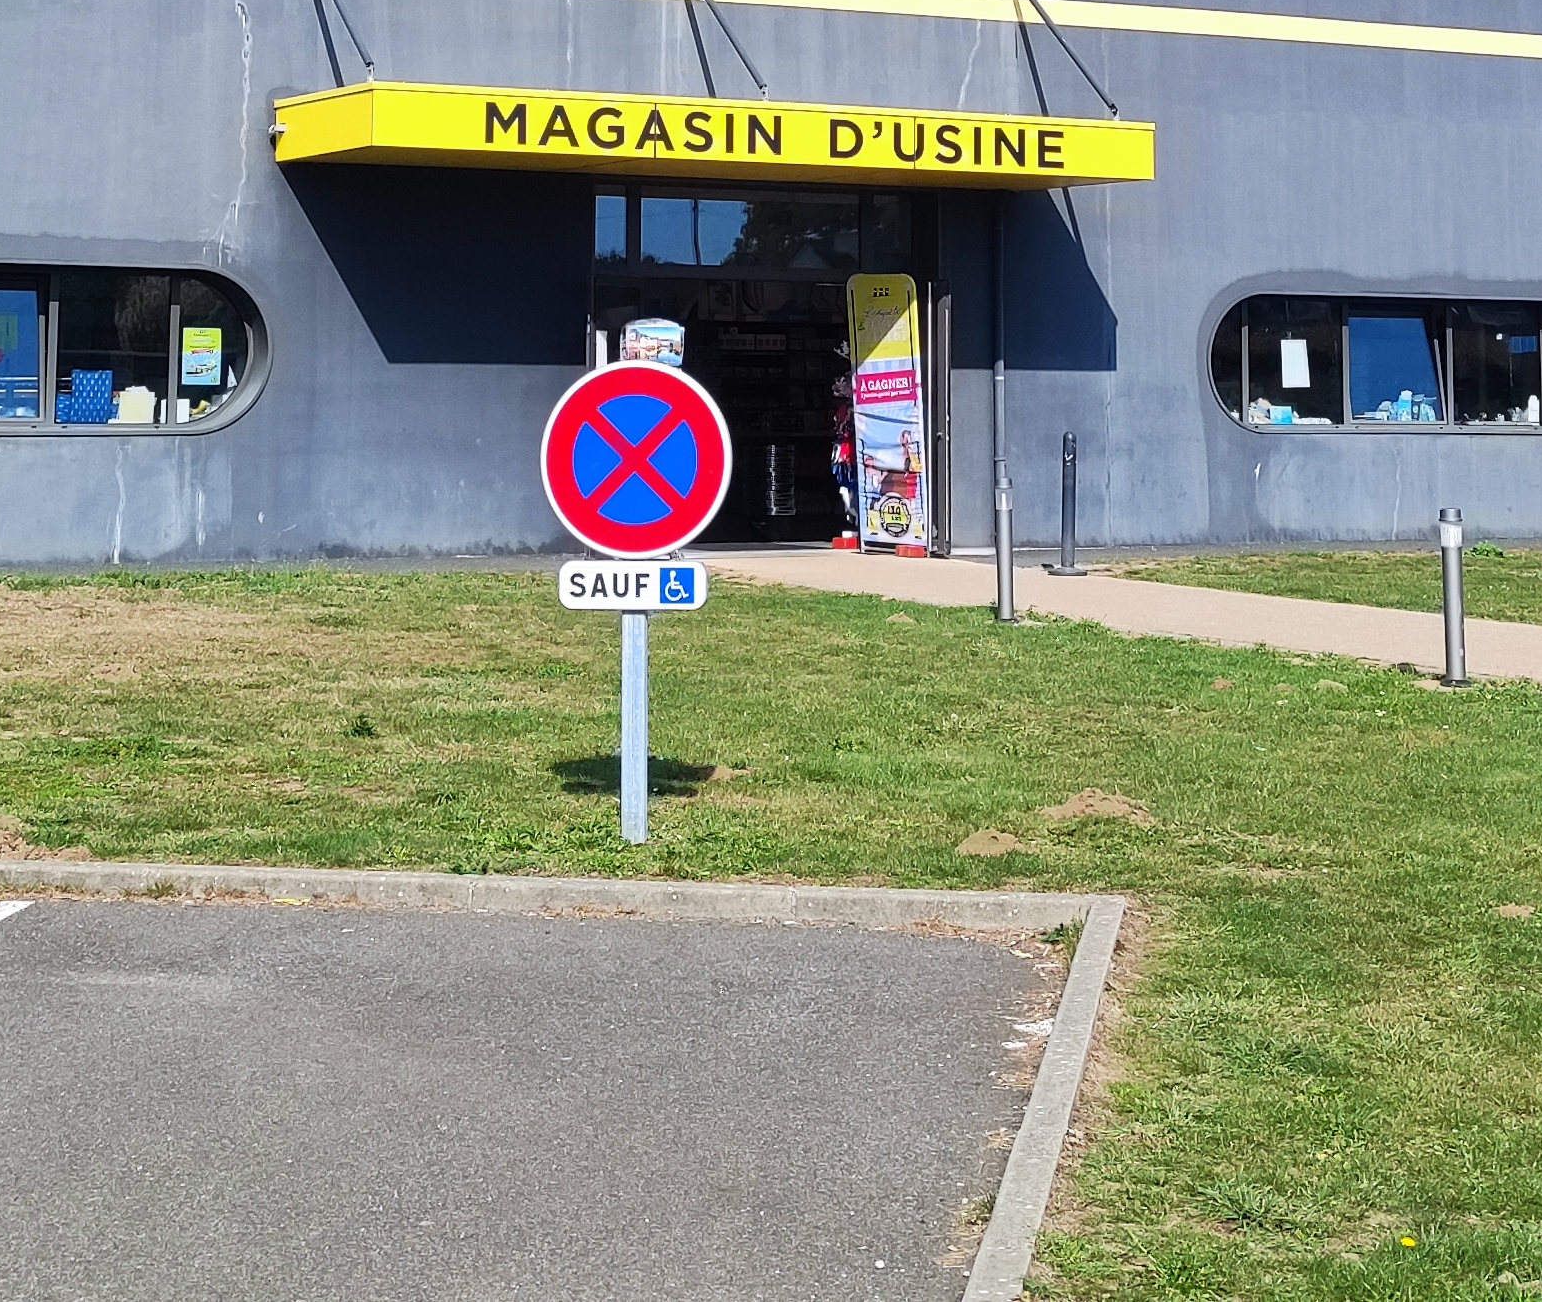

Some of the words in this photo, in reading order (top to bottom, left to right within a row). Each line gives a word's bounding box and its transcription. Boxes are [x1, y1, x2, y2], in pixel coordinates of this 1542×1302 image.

[484, 101, 782, 156] MAGASIN
[829, 118, 1064, 169] D'USINE
[569, 572, 650, 598] SAUF
